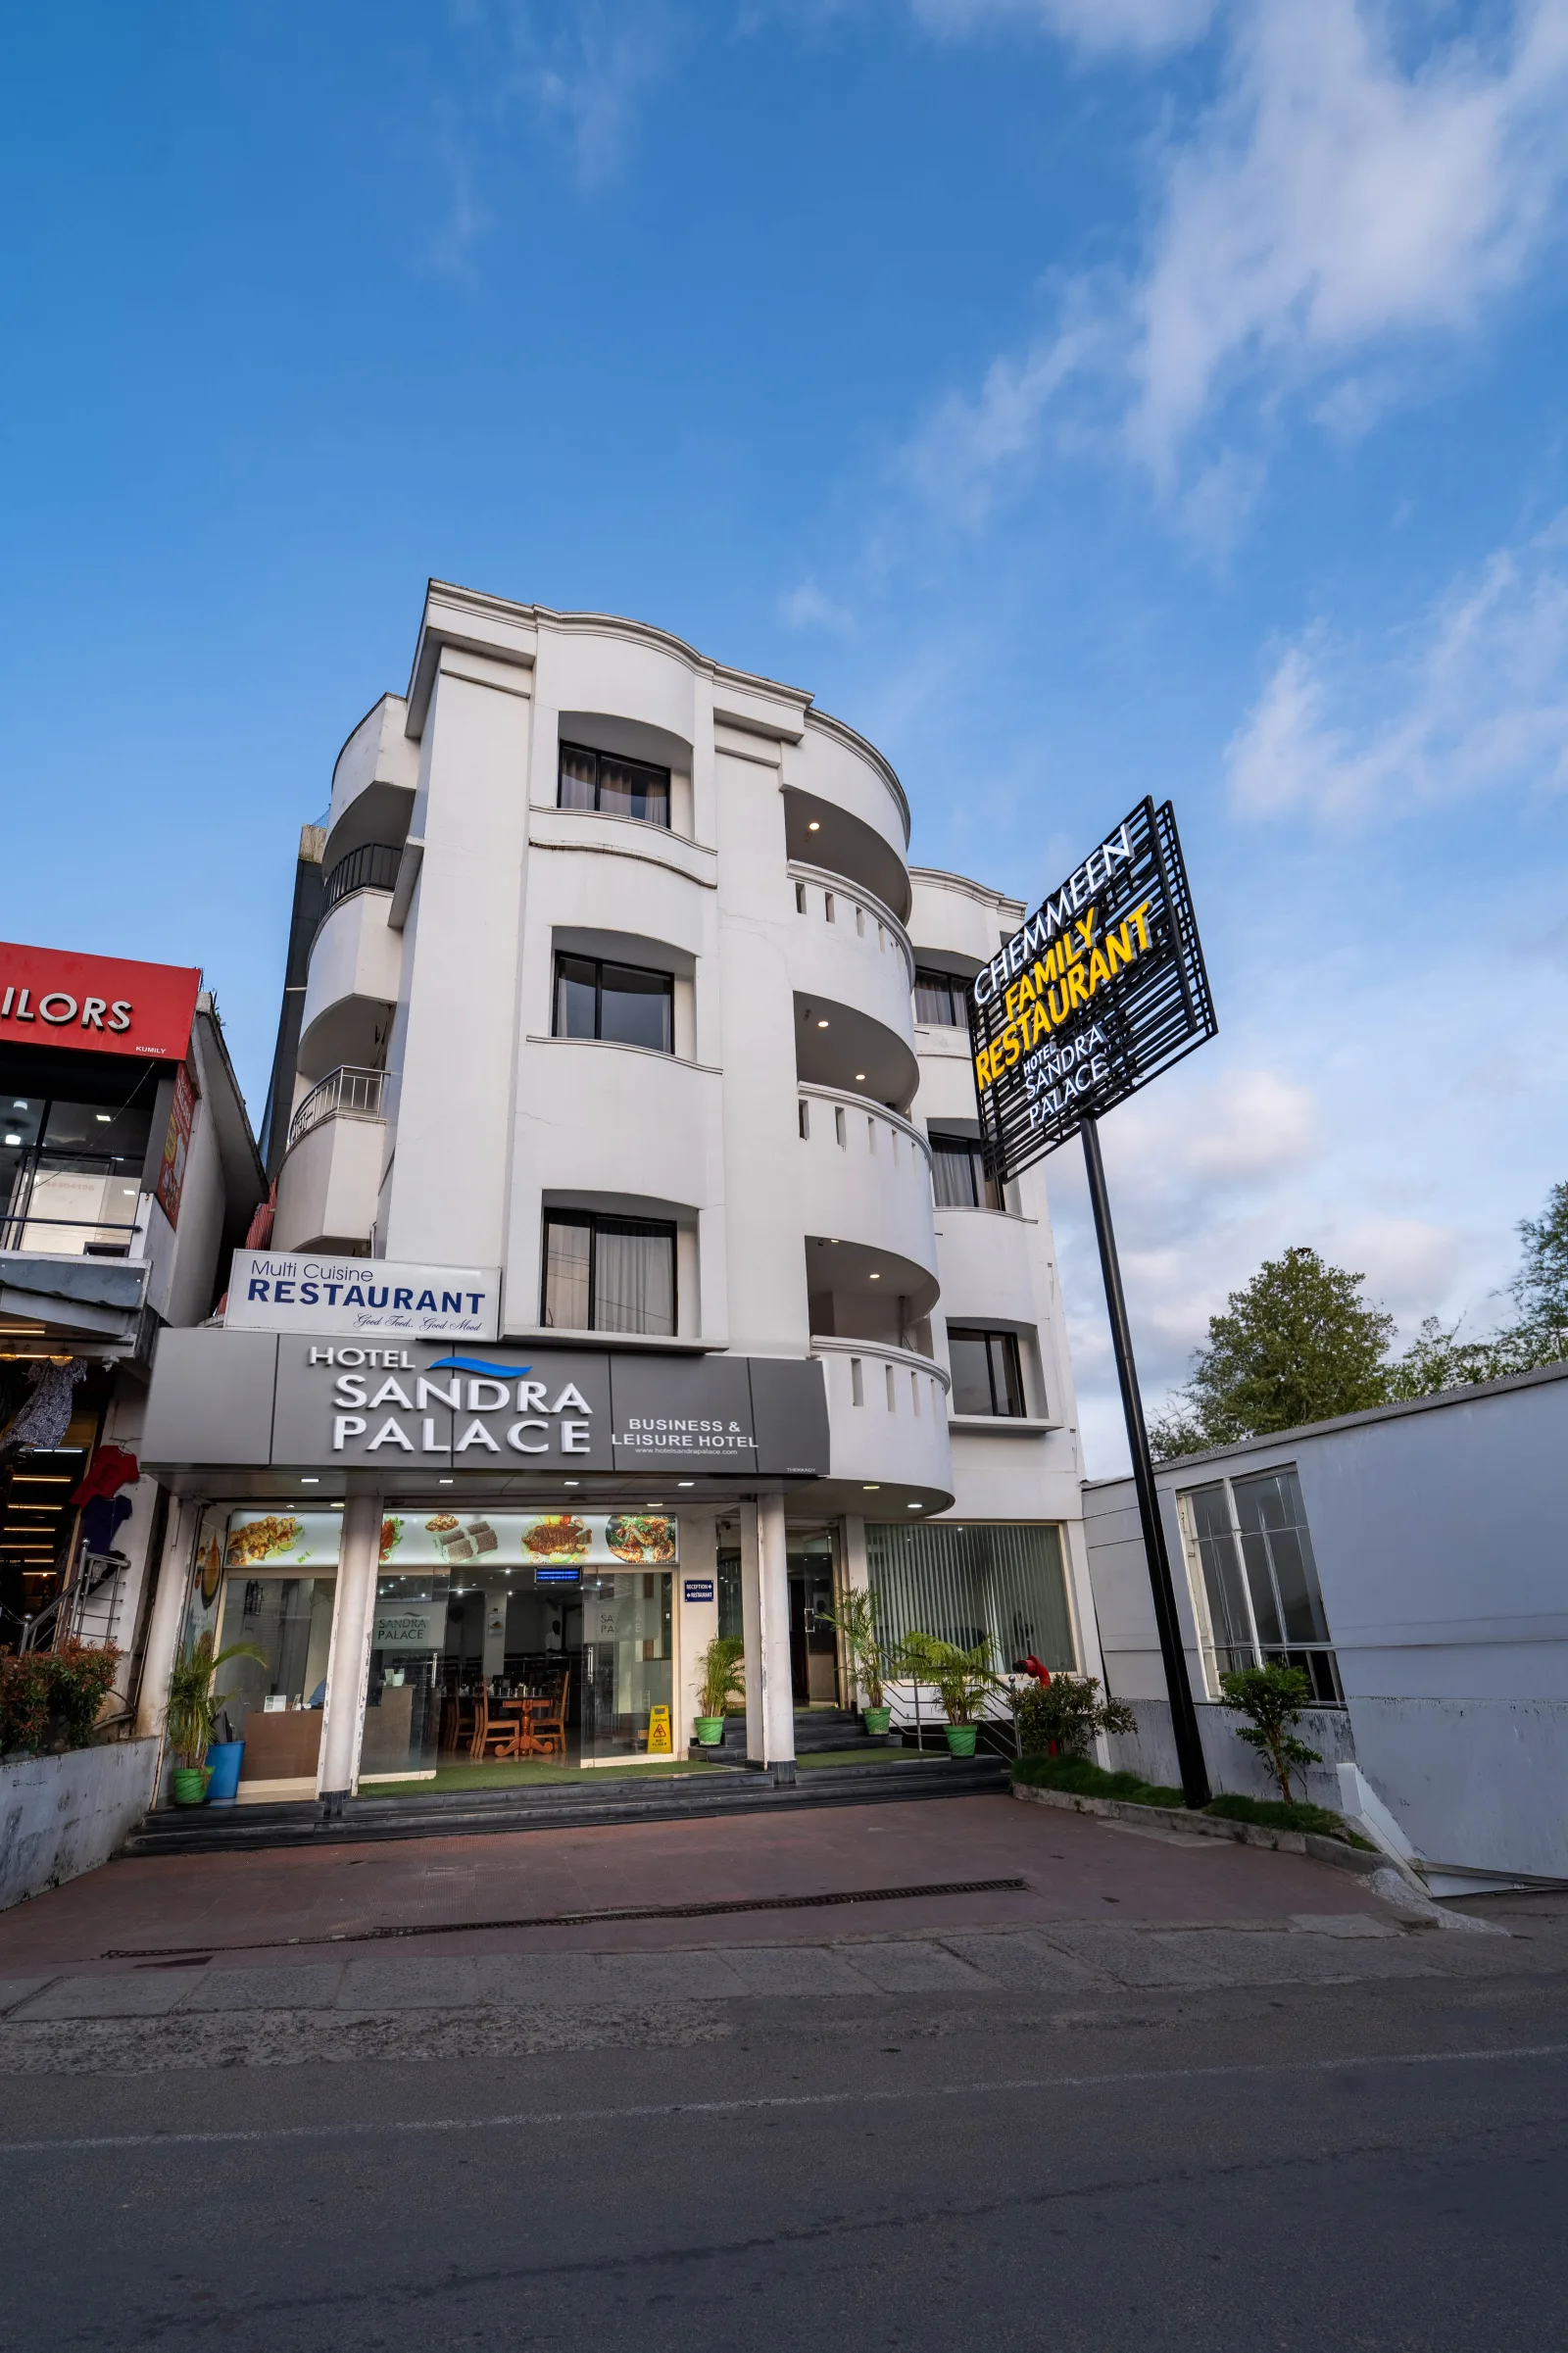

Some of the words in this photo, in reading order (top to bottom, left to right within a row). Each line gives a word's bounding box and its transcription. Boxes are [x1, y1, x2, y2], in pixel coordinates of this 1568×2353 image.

[974, 822, 1136, 1006] CHEMMEEN
[1004, 907, 1099, 1022] FAMILY
[1, 986, 133, 1031] ILORS
[975, 901, 1153, 1092] RESTAURANT
[135, 1046, 167, 1054] KUMILY
[1023, 1042, 1058, 1077] HOTEL
[1025, 1024, 1107, 1100] SANDRA
[1029, 1053, 1109, 1130] PALACE
[251, 1259, 297, 1278] Multi
[303, 1263, 373, 1282] Cuisine
[247, 1278, 486, 1315] RESTAURANT
[353, 1312, 383, 1328] Good
[418, 1317, 449, 1331] Good
[450, 1318, 483, 1332] Mood
[309, 1347, 416, 1370] HOTEL
[332, 1374, 594, 1414] SANDRA
[332, 1415, 591, 1454] PALACE
[612, 1433, 693, 1446] LEISURE
[699, 1436, 760, 1448] HOTEL
[628, 1418, 723, 1433] BUSINESS
[728, 1421, 741, 1433] &
[635, 1447, 738, 1456] www.hotelsandrapalace.com
[377, 1629, 424, 1640] PALACE
[378, 1618, 426, 1629] SANDRA
